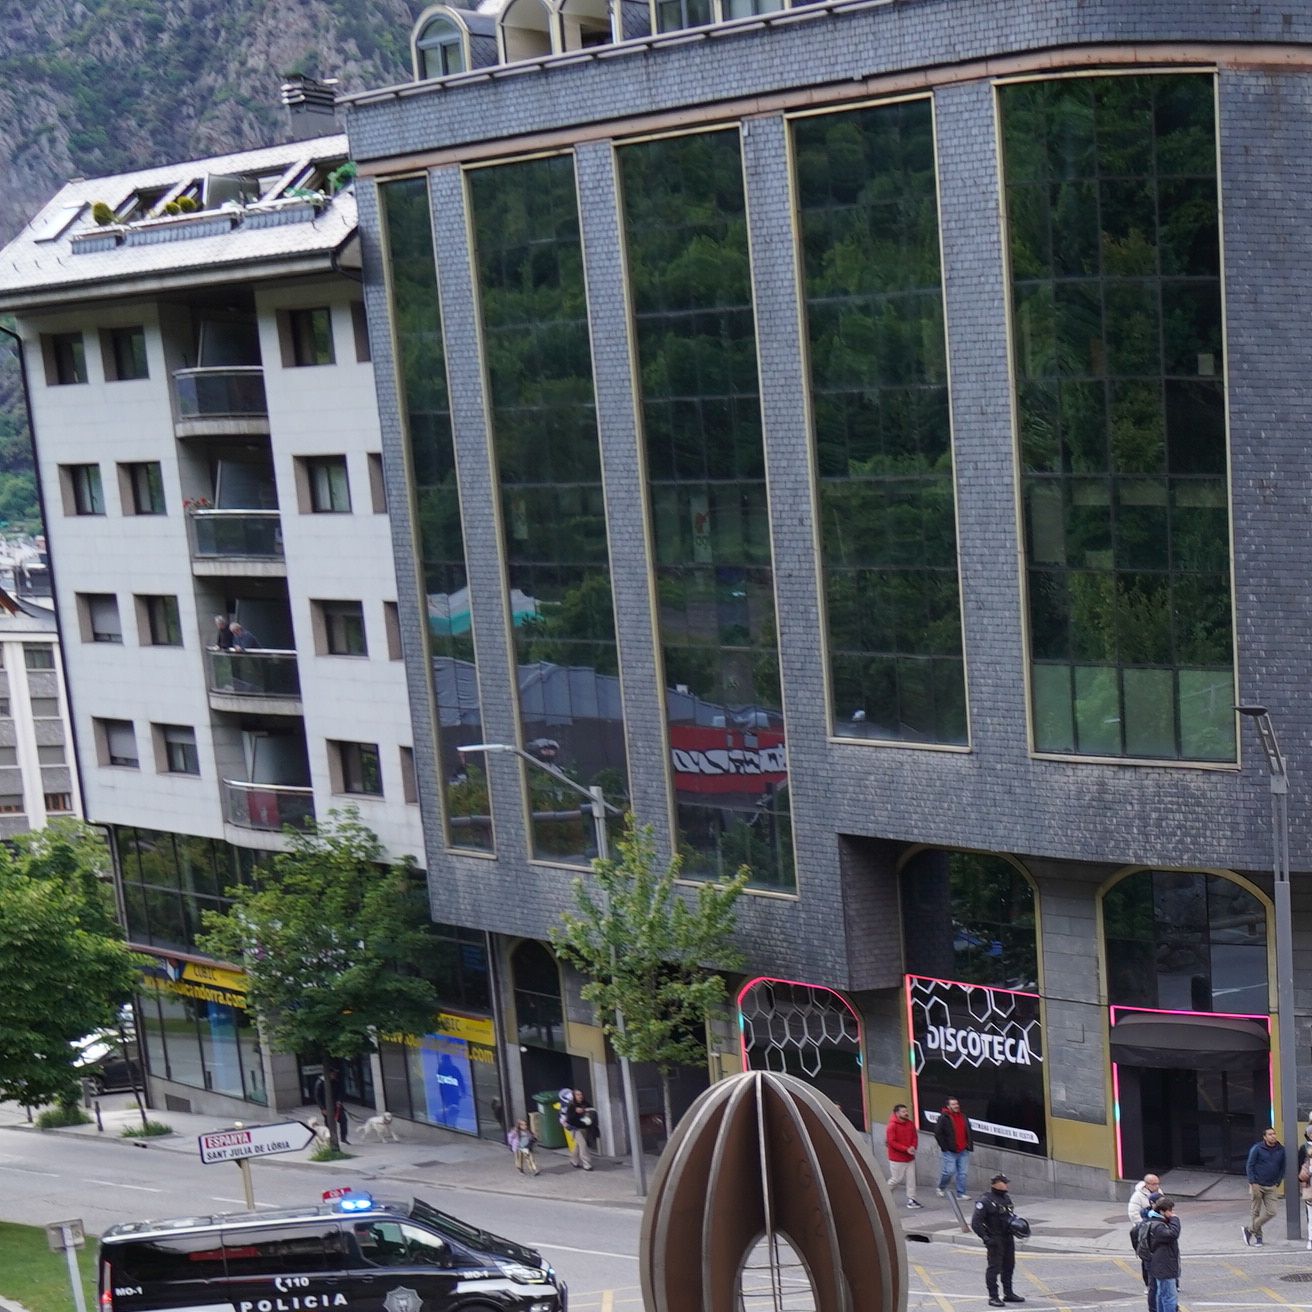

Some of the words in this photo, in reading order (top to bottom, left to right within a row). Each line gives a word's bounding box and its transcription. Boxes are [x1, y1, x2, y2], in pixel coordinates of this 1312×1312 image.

[926, 1025, 1031, 1065] DISCOTECA
[207, 1132, 250, 1148] ESPANYA
[206, 1151, 228, 1161] SANT
[285, 1277, 310, 1288] 110
[114, 1285, 143, 1297] MO-1
